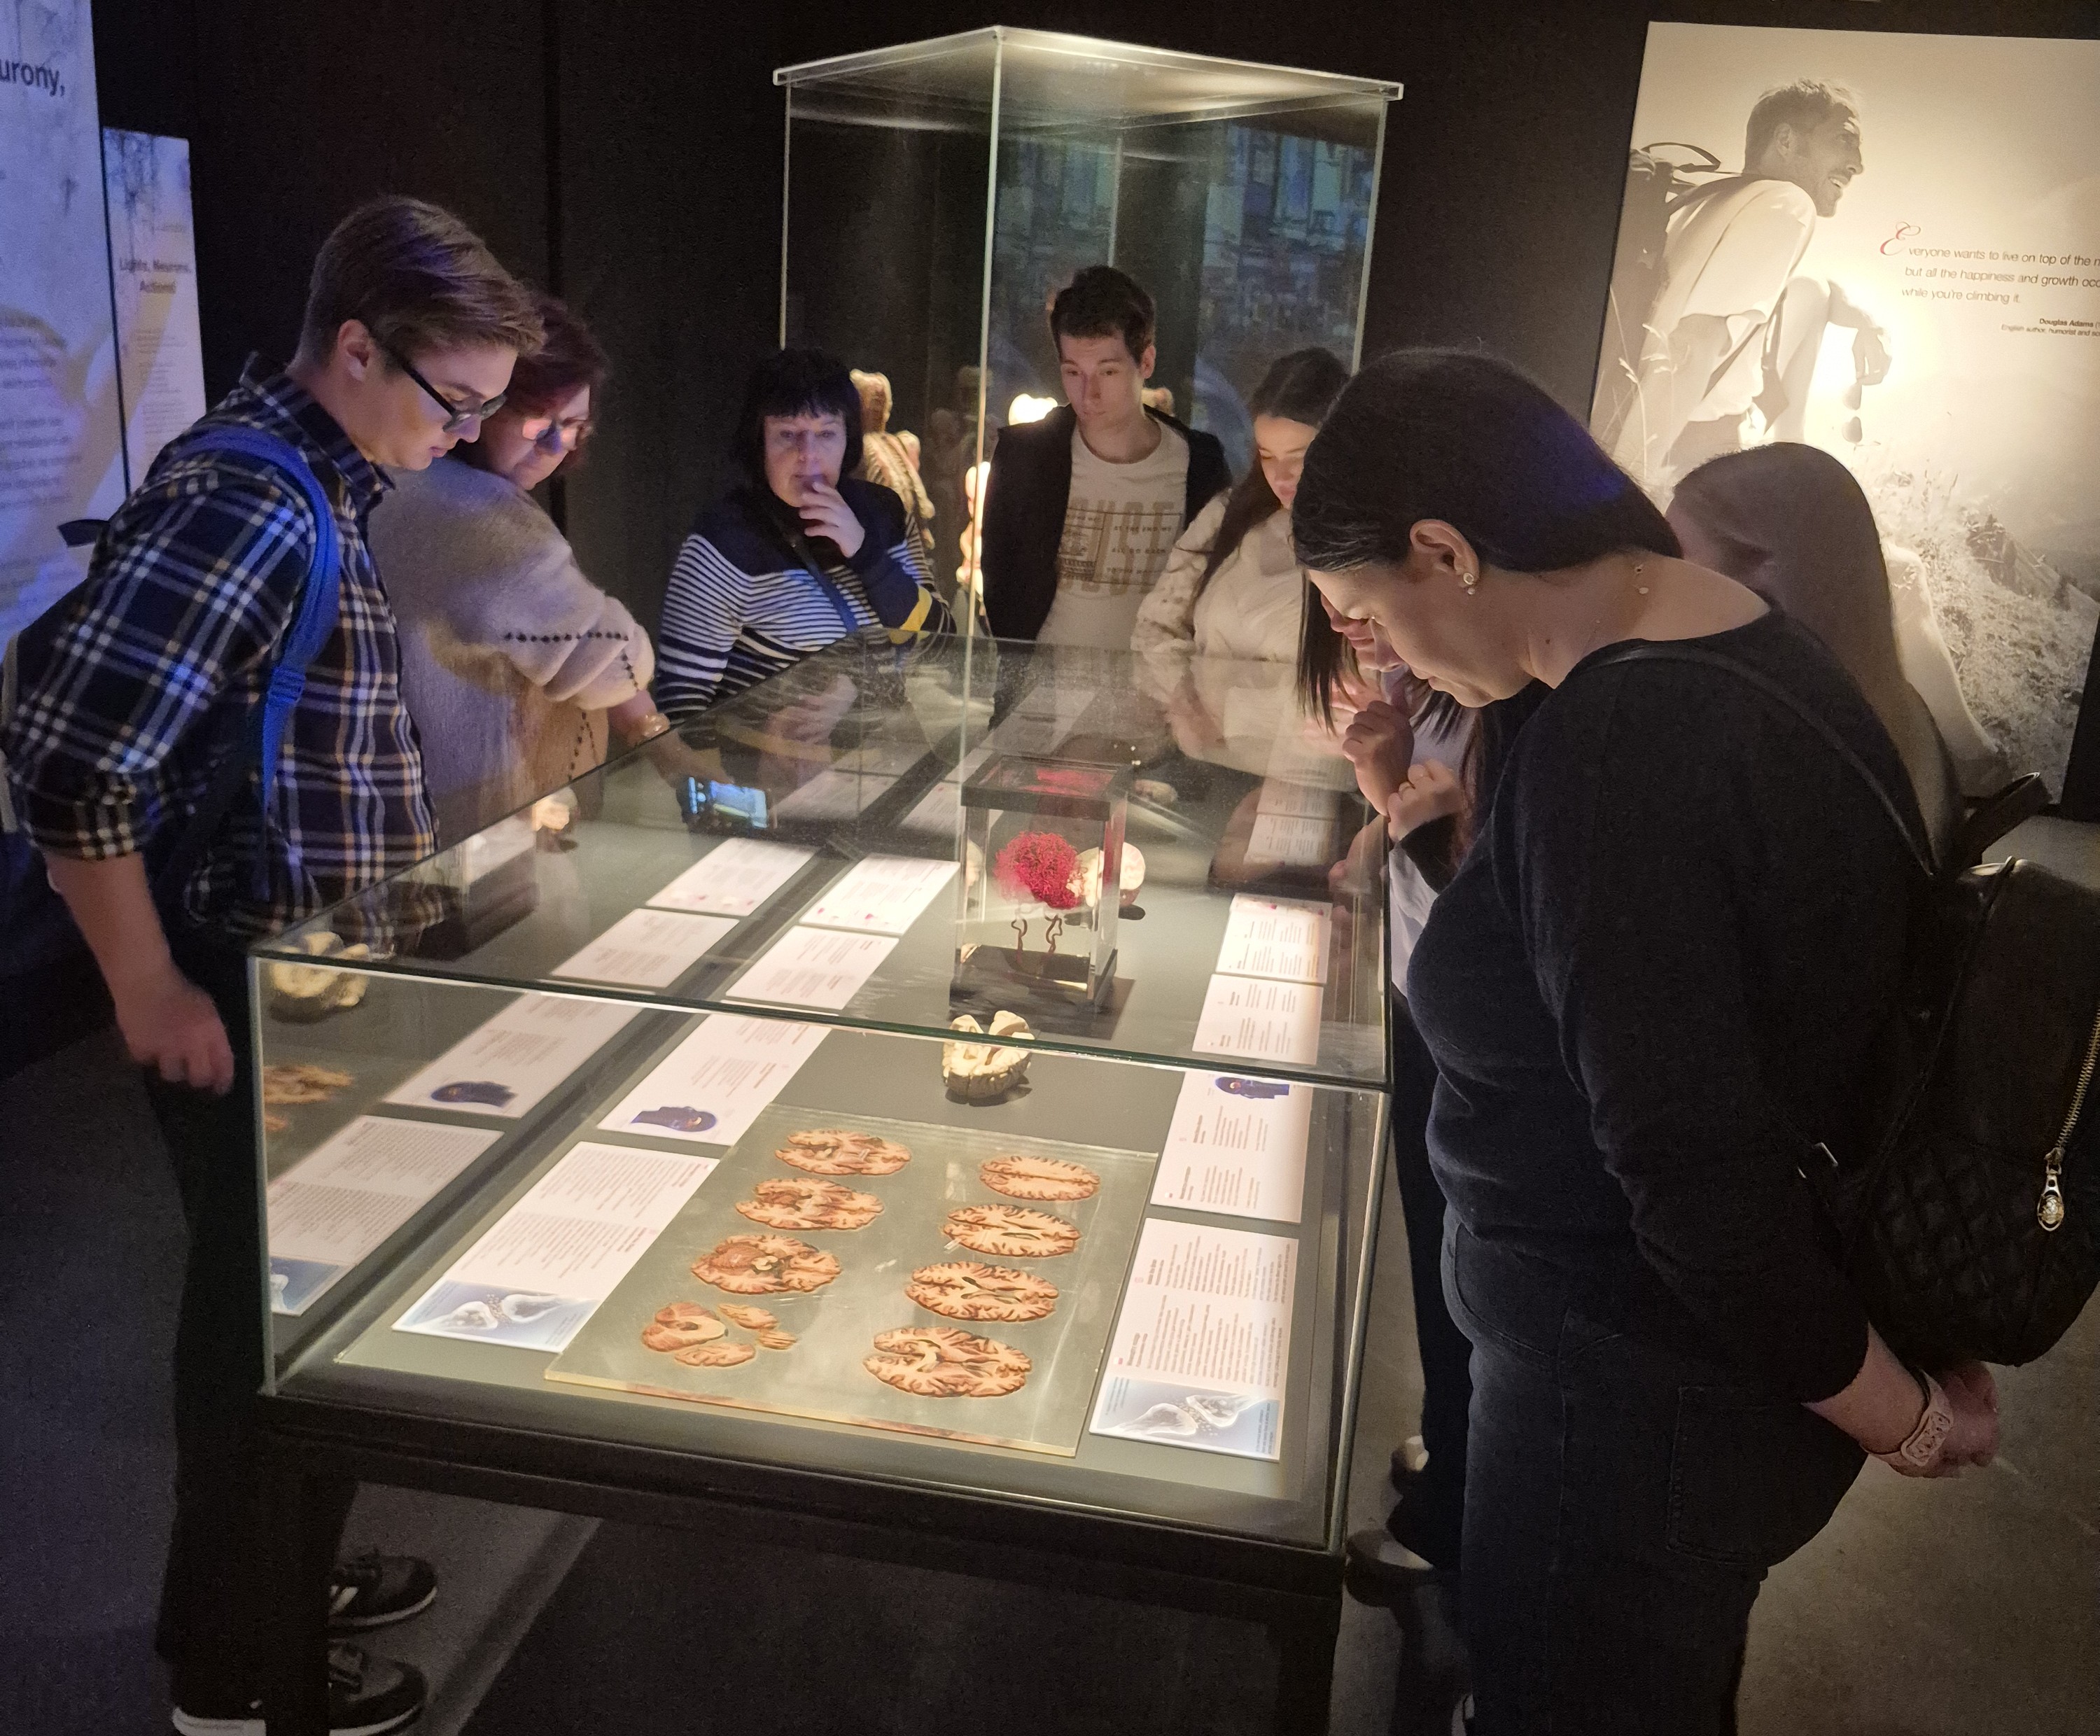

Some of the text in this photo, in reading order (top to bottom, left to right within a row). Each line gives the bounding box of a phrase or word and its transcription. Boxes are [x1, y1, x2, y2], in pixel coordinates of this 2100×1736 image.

[1954, 250, 1985, 260] wants
[1989, 251, 1999, 260] to
[2002, 251, 2019, 262] live
[2022, 254, 2036, 262] on
[2039, 253, 2057, 266] top
[2059, 254, 2071, 265] of
[2074, 255, 2091, 266] the
[1905, 267, 1922, 277] but
[1926, 268, 1938, 278] all
[1940, 269, 1957, 279] the
[1960, 270, 2015, 282] happiness
[2017, 274, 2038, 284] and
[2041, 275, 2078, 287] growth
[1902, 288, 1928, 298] while
[1931, 289, 1963, 300] you're
[1966, 290, 2010, 304] climbing
[2039, 318, 2068, 327] Douglas
[2068, 319, 2094, 328] Adams
[2048, 328, 2076, 336] humorist
